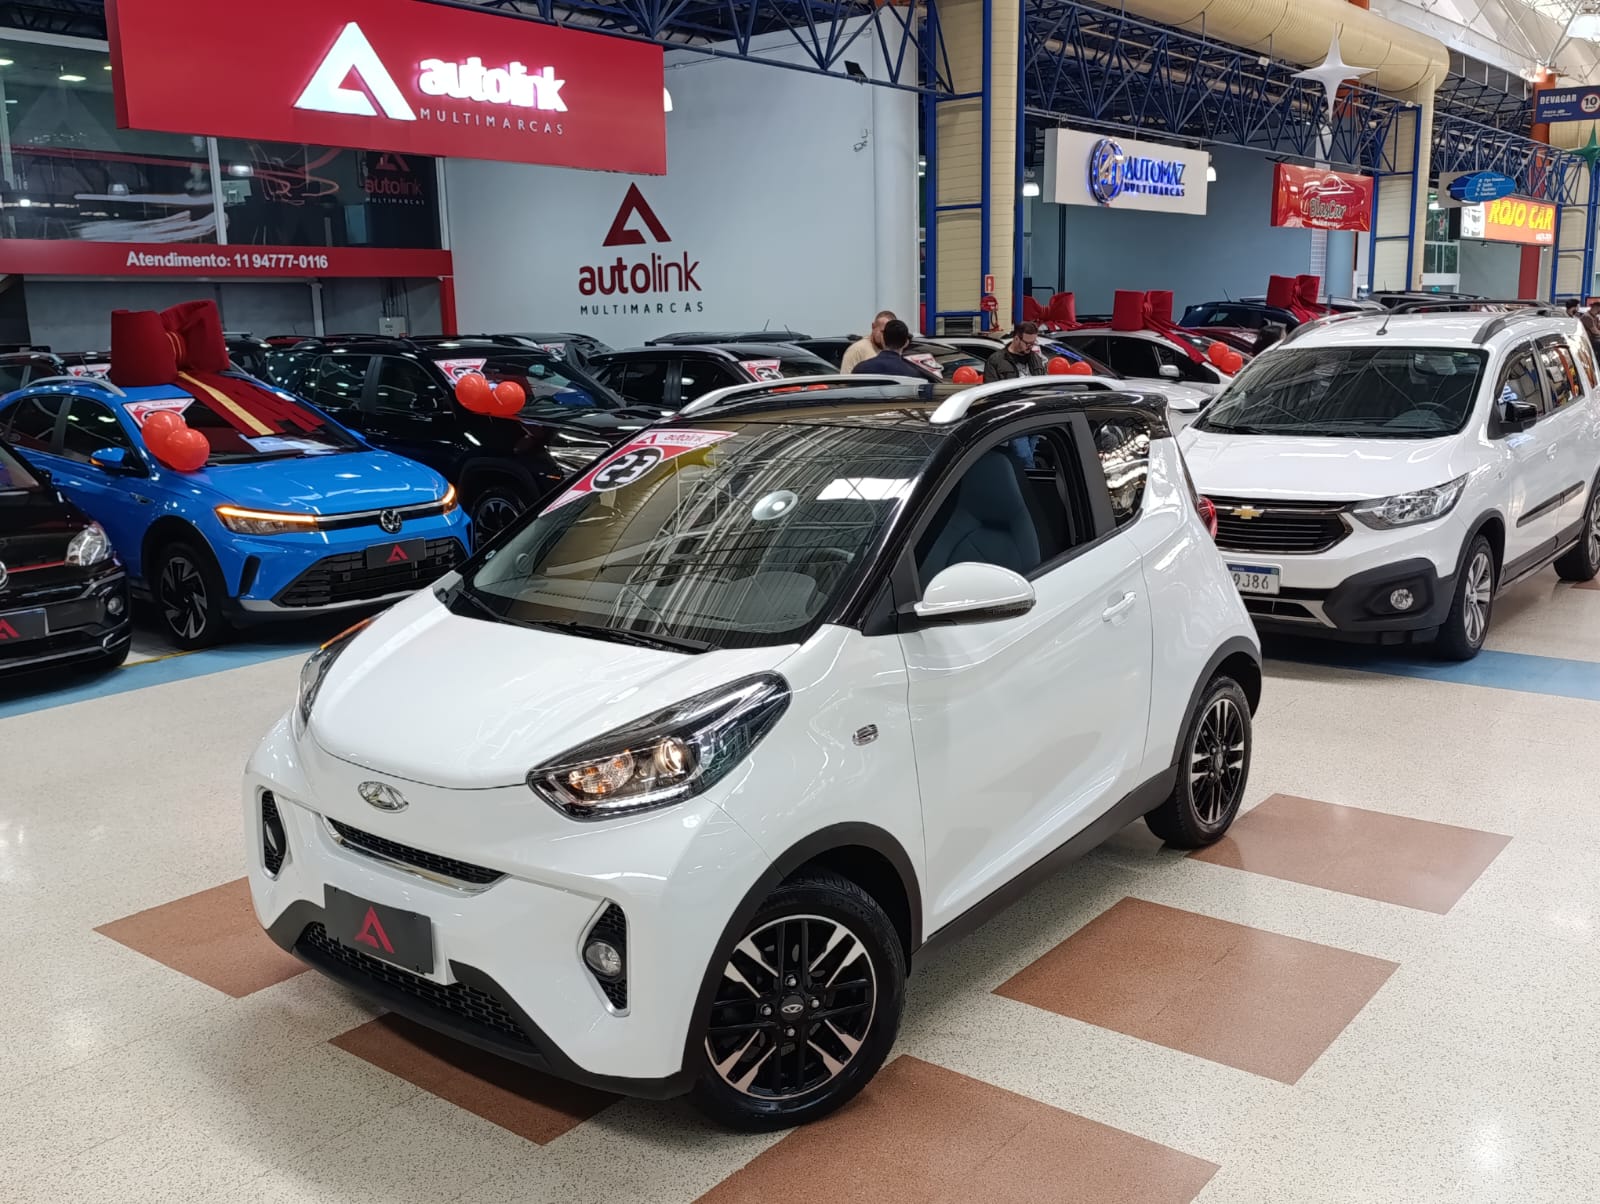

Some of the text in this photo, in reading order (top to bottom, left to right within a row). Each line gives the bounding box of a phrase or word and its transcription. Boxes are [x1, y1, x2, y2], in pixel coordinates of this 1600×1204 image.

[419, 56, 568, 112] autolink
[1540, 94, 1598, 106] DEVAGAR 10
[420, 108, 563, 135] MULTIMARCAS
[1124, 156, 1186, 186] AUTOMAZ
[1487, 199, 1554, 231] ROJO CAR
[126, 250, 328, 269] Atendimento: 11 94777-0116
[578, 251, 702, 296] autolink
[580, 301, 704, 316] MULTIMARCAS
[597, 454, 656, 483] 23
